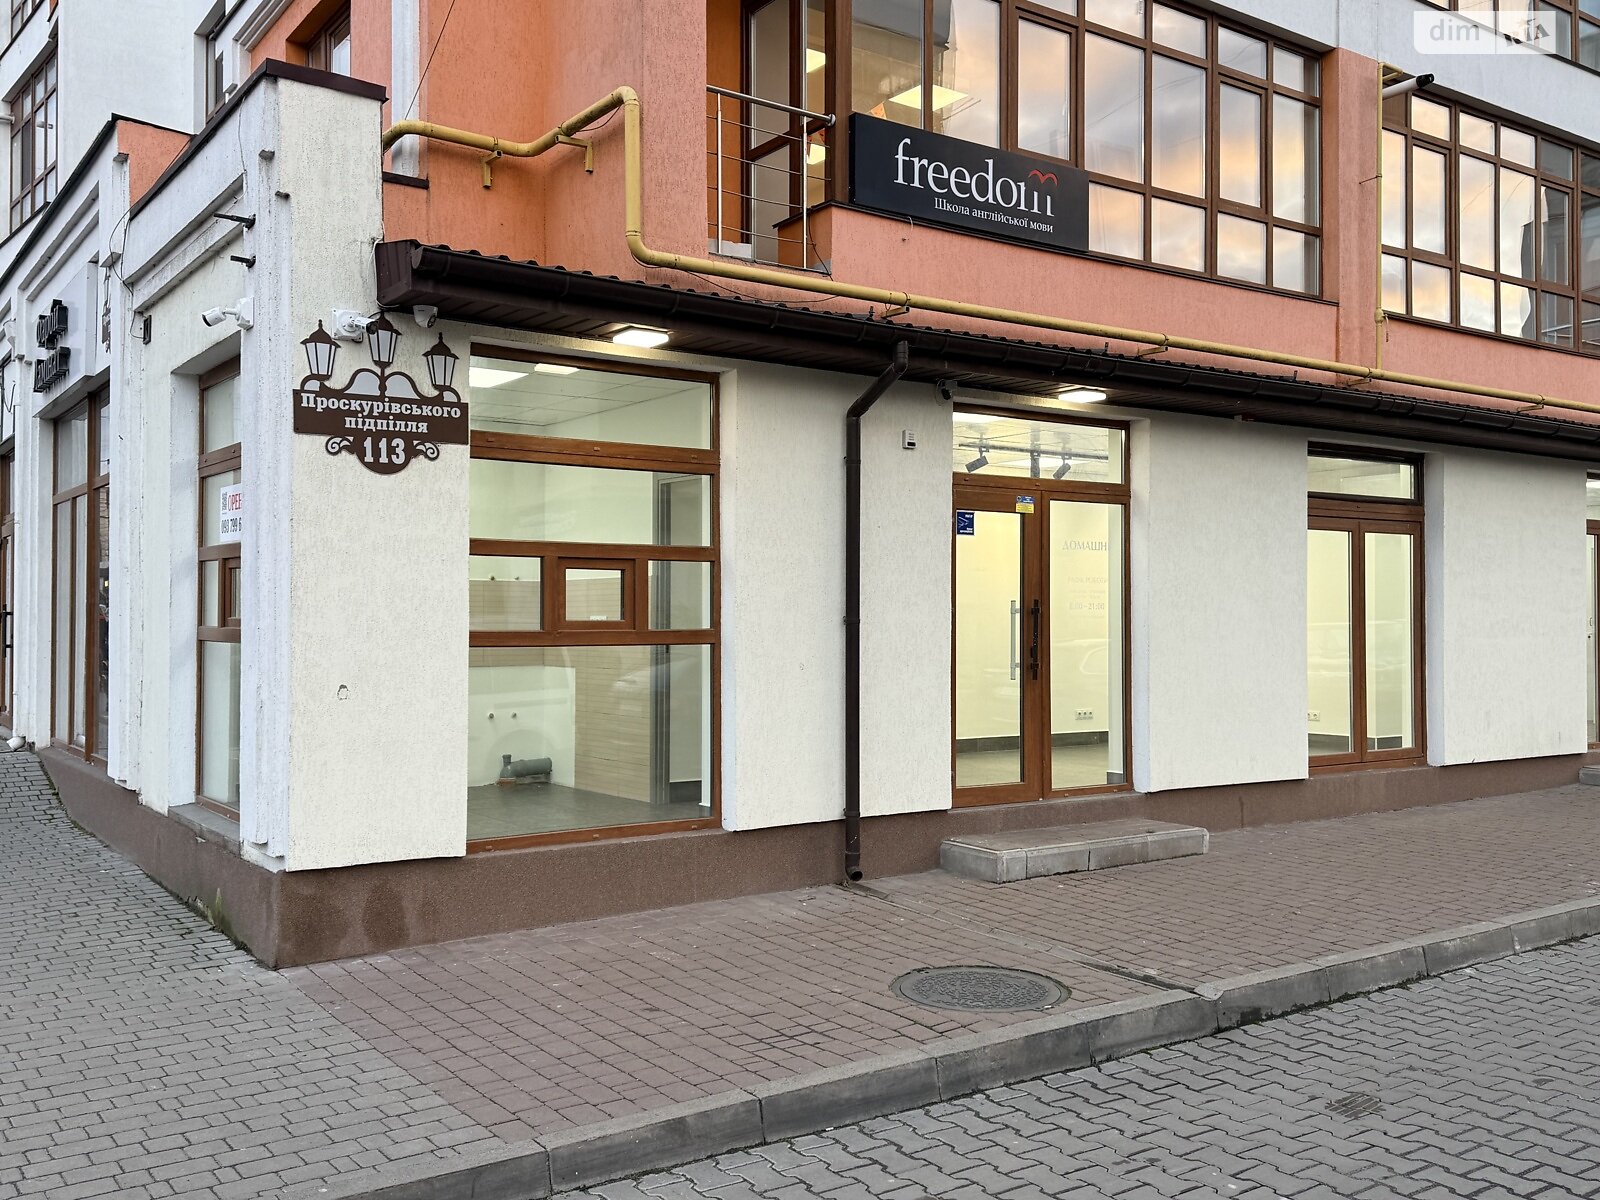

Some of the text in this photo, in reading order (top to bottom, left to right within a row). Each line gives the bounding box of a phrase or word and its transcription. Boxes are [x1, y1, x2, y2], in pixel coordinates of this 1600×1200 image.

[893, 137, 1058, 217] freedom
[934, 197, 1054, 233] Школа англійської мови
[300, 392, 461, 418] Проскурівського
[344, 413, 428, 433] підпілля
[363, 436, 406, 465] 113
